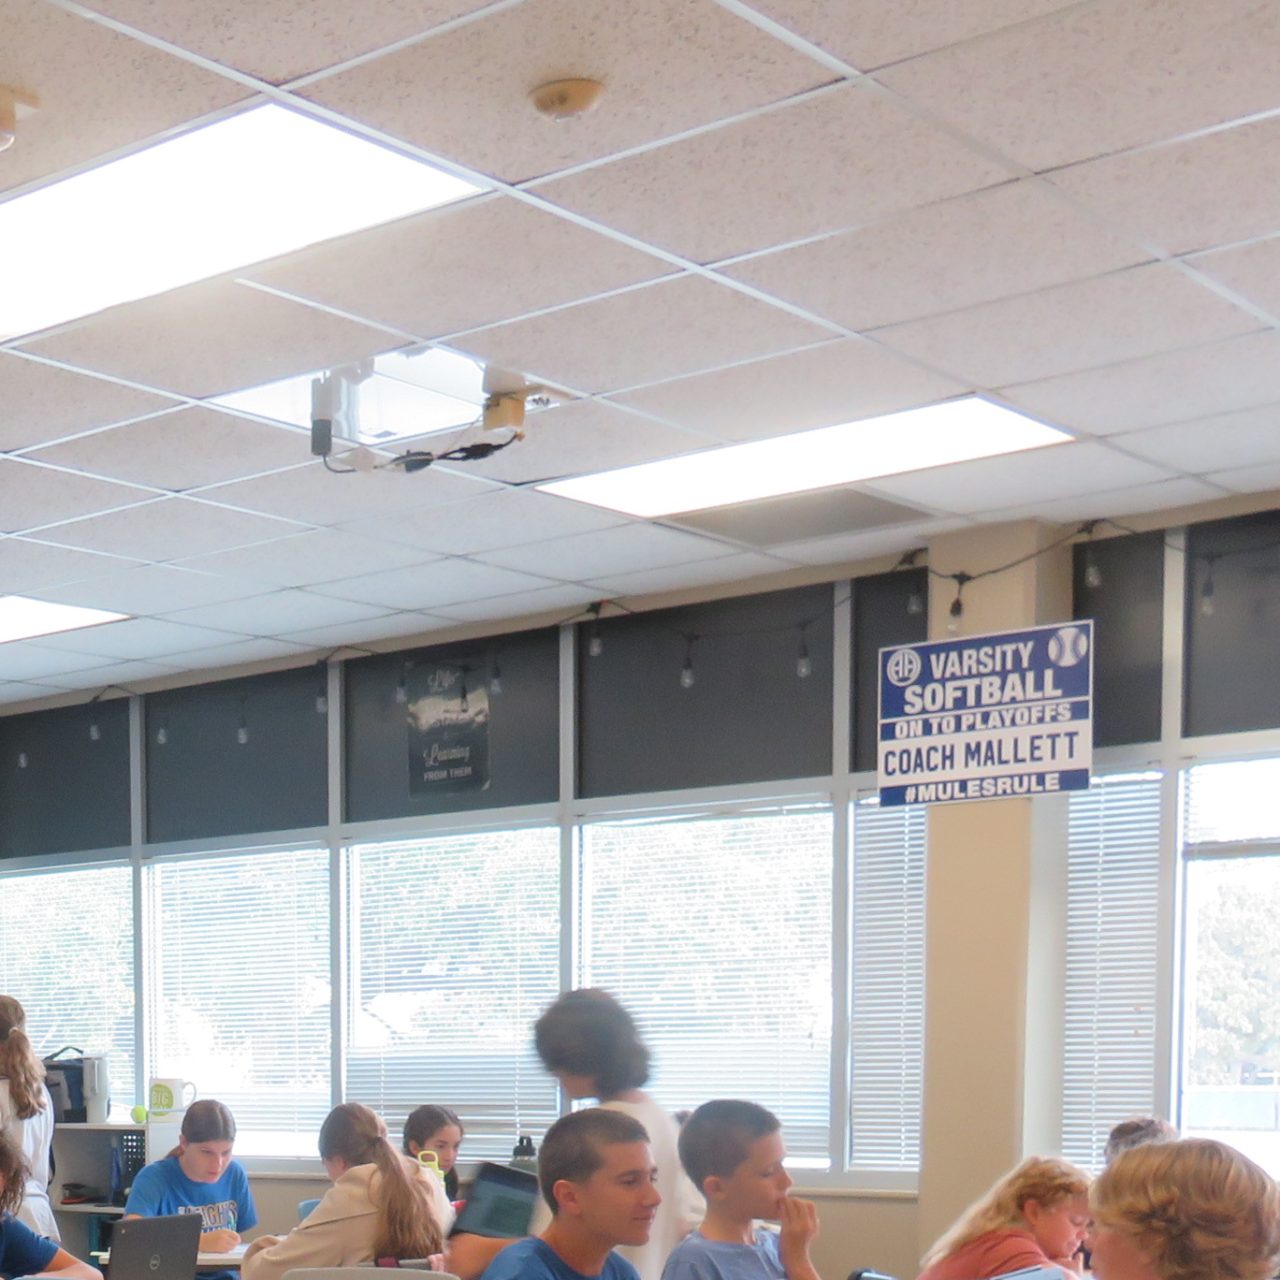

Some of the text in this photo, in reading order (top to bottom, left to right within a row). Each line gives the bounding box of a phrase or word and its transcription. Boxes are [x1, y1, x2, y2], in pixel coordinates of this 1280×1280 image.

[930, 640, 1034, 679] VARSITY
[904, 669, 1062, 714] SOFTBALL
[895, 703, 1071, 739] ON TO PLAYOFFS
[884, 731, 1079, 776] COACH MALLETT
[905, 773, 1060, 803] #MULESRULE
